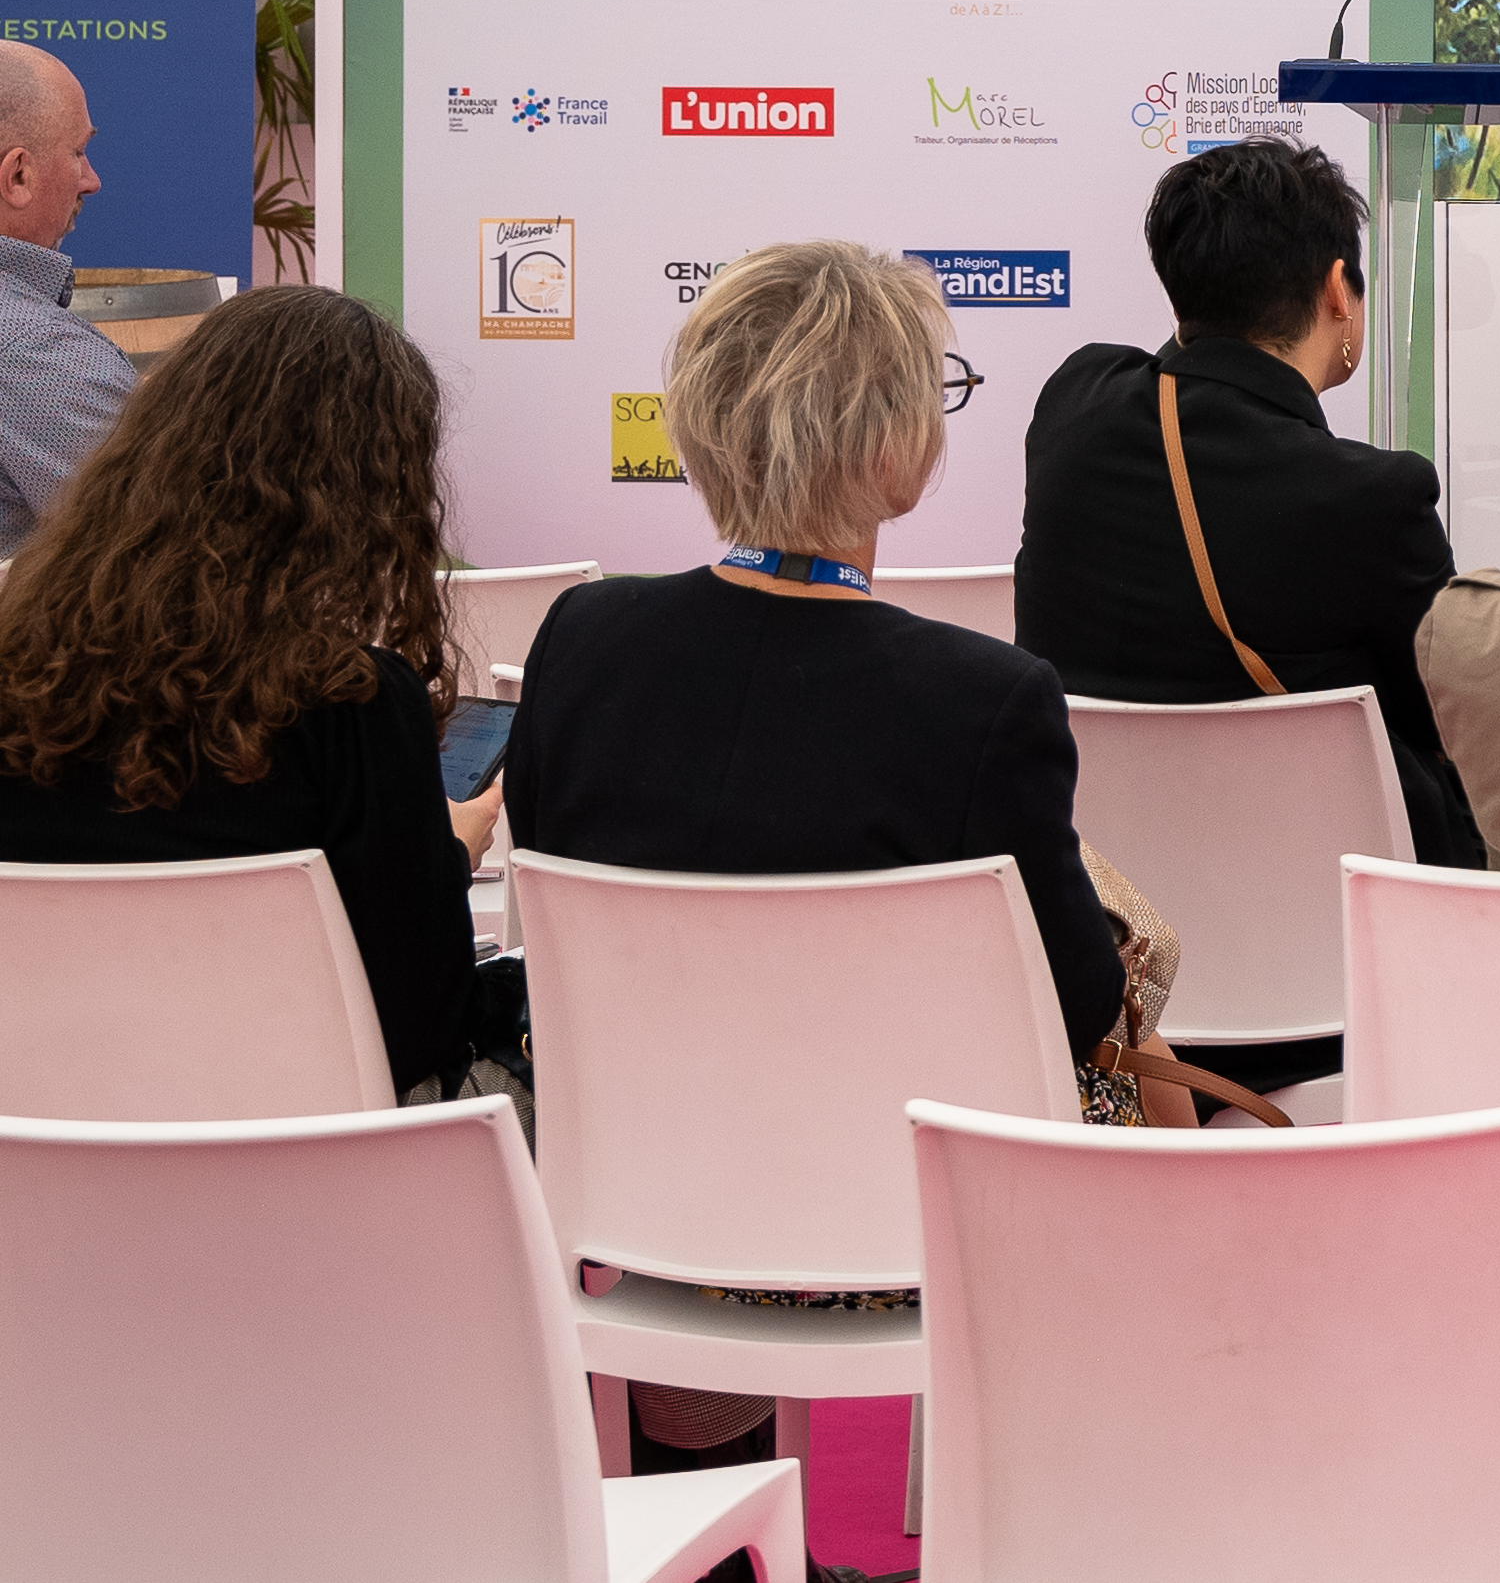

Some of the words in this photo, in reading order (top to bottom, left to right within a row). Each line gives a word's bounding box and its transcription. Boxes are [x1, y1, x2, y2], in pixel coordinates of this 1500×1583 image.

[558, 97, 608, 110] France
[557, 112, 607, 125] Travail
[935, 258, 950, 268] La
[954, 257, 999, 270] Région
[936, 267, 1065, 296] randEst
